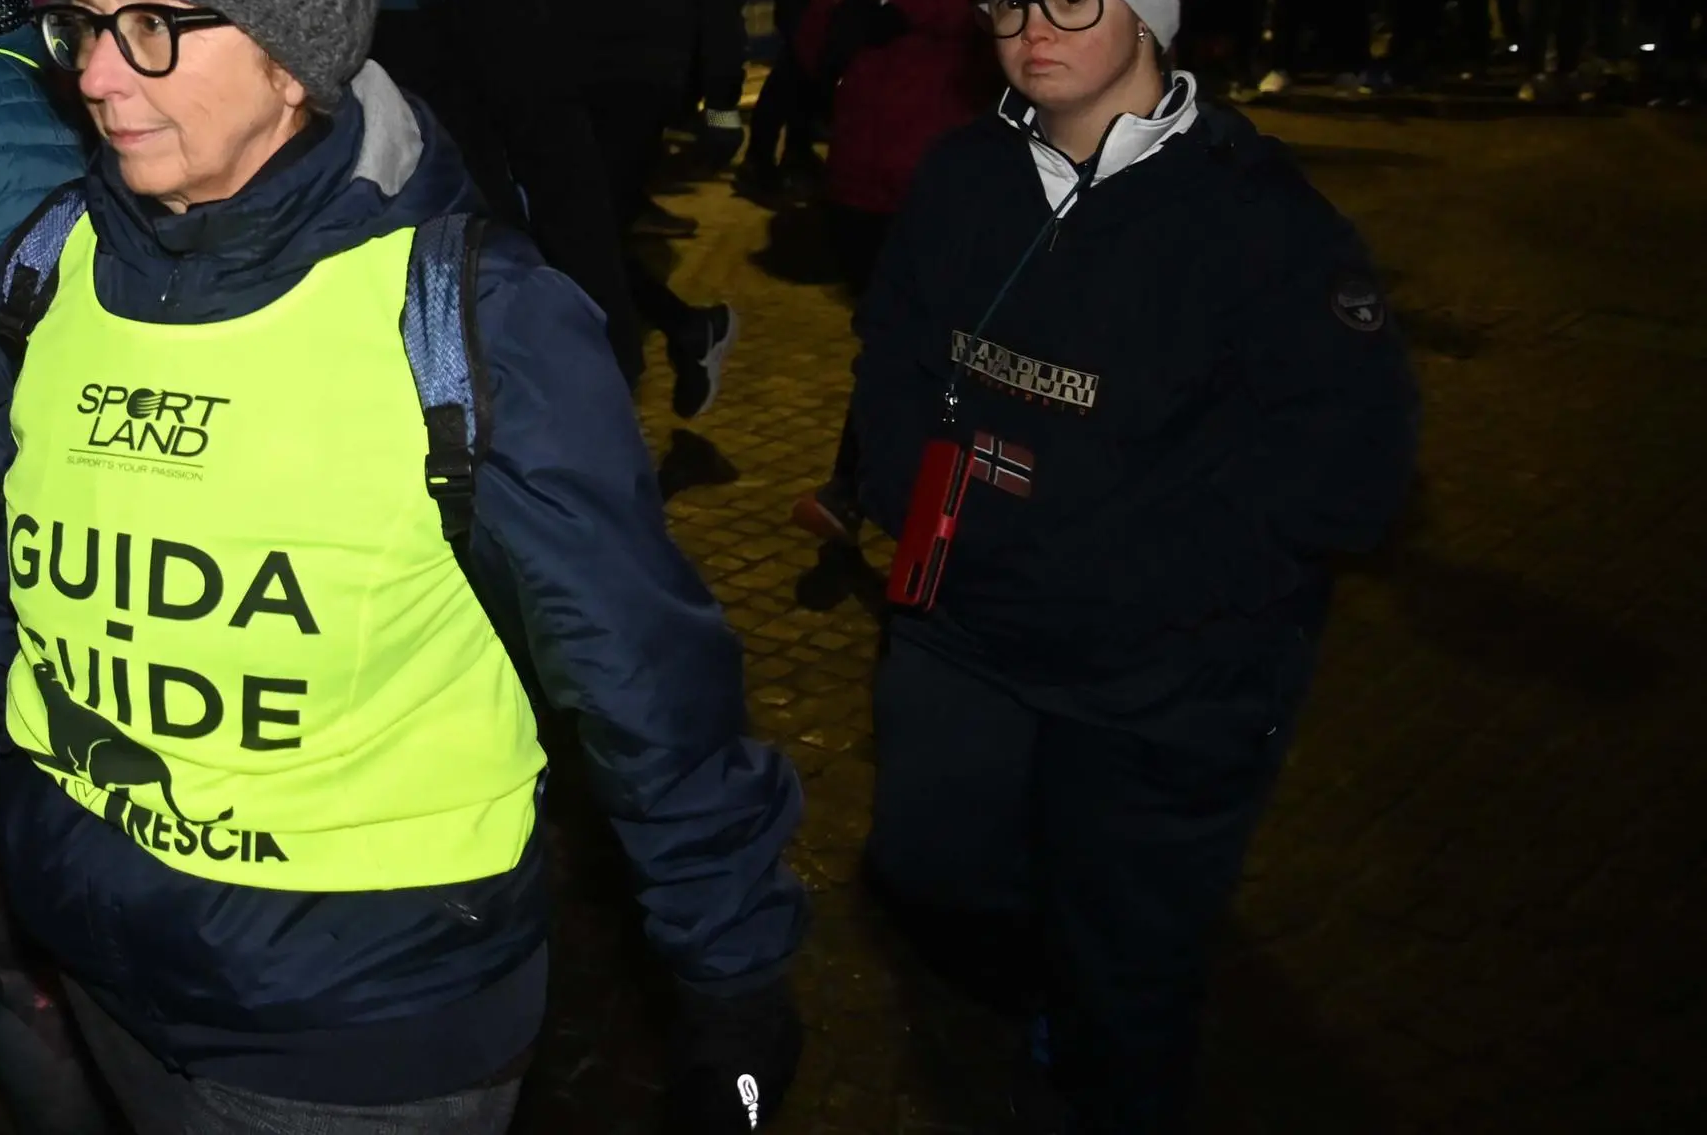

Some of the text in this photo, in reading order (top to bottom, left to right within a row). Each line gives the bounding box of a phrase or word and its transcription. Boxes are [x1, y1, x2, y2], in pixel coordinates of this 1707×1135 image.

[76, 382, 231, 427] SPORT
[88, 417, 209, 458] LAND
[66, 455, 204, 482] SUPPORTS YOUR PASSION
[9, 513, 321, 636] GUIDA
